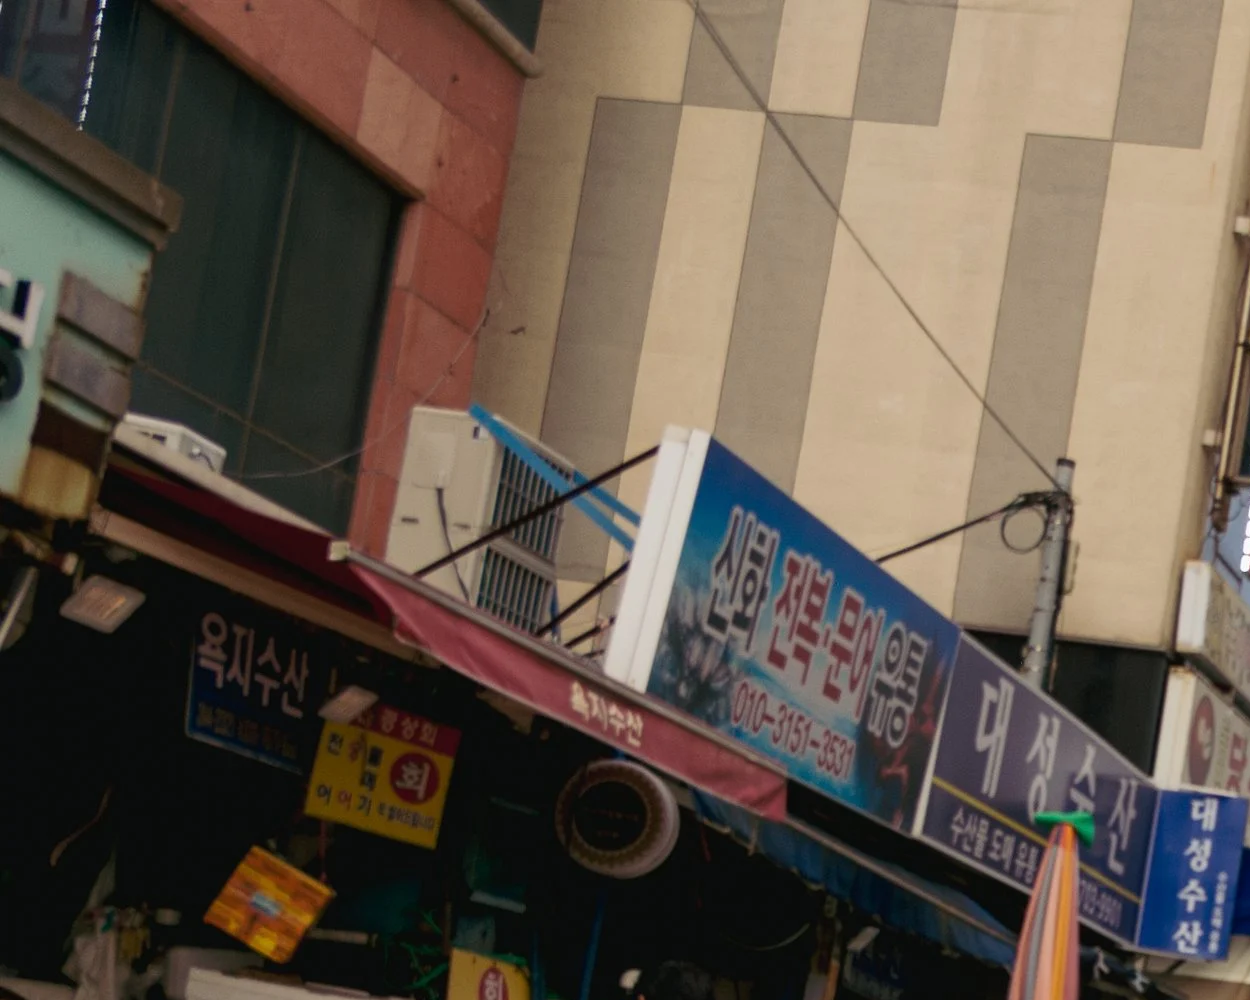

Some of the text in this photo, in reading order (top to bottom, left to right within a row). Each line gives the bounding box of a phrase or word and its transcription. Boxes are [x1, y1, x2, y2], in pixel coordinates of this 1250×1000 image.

[867, 621, 929, 750] 유통
[951, 806, 991, 861] 수산물
[975, 677, 1138, 877] 대성수산
[1172, 796, 1220, 955] 대성수산
